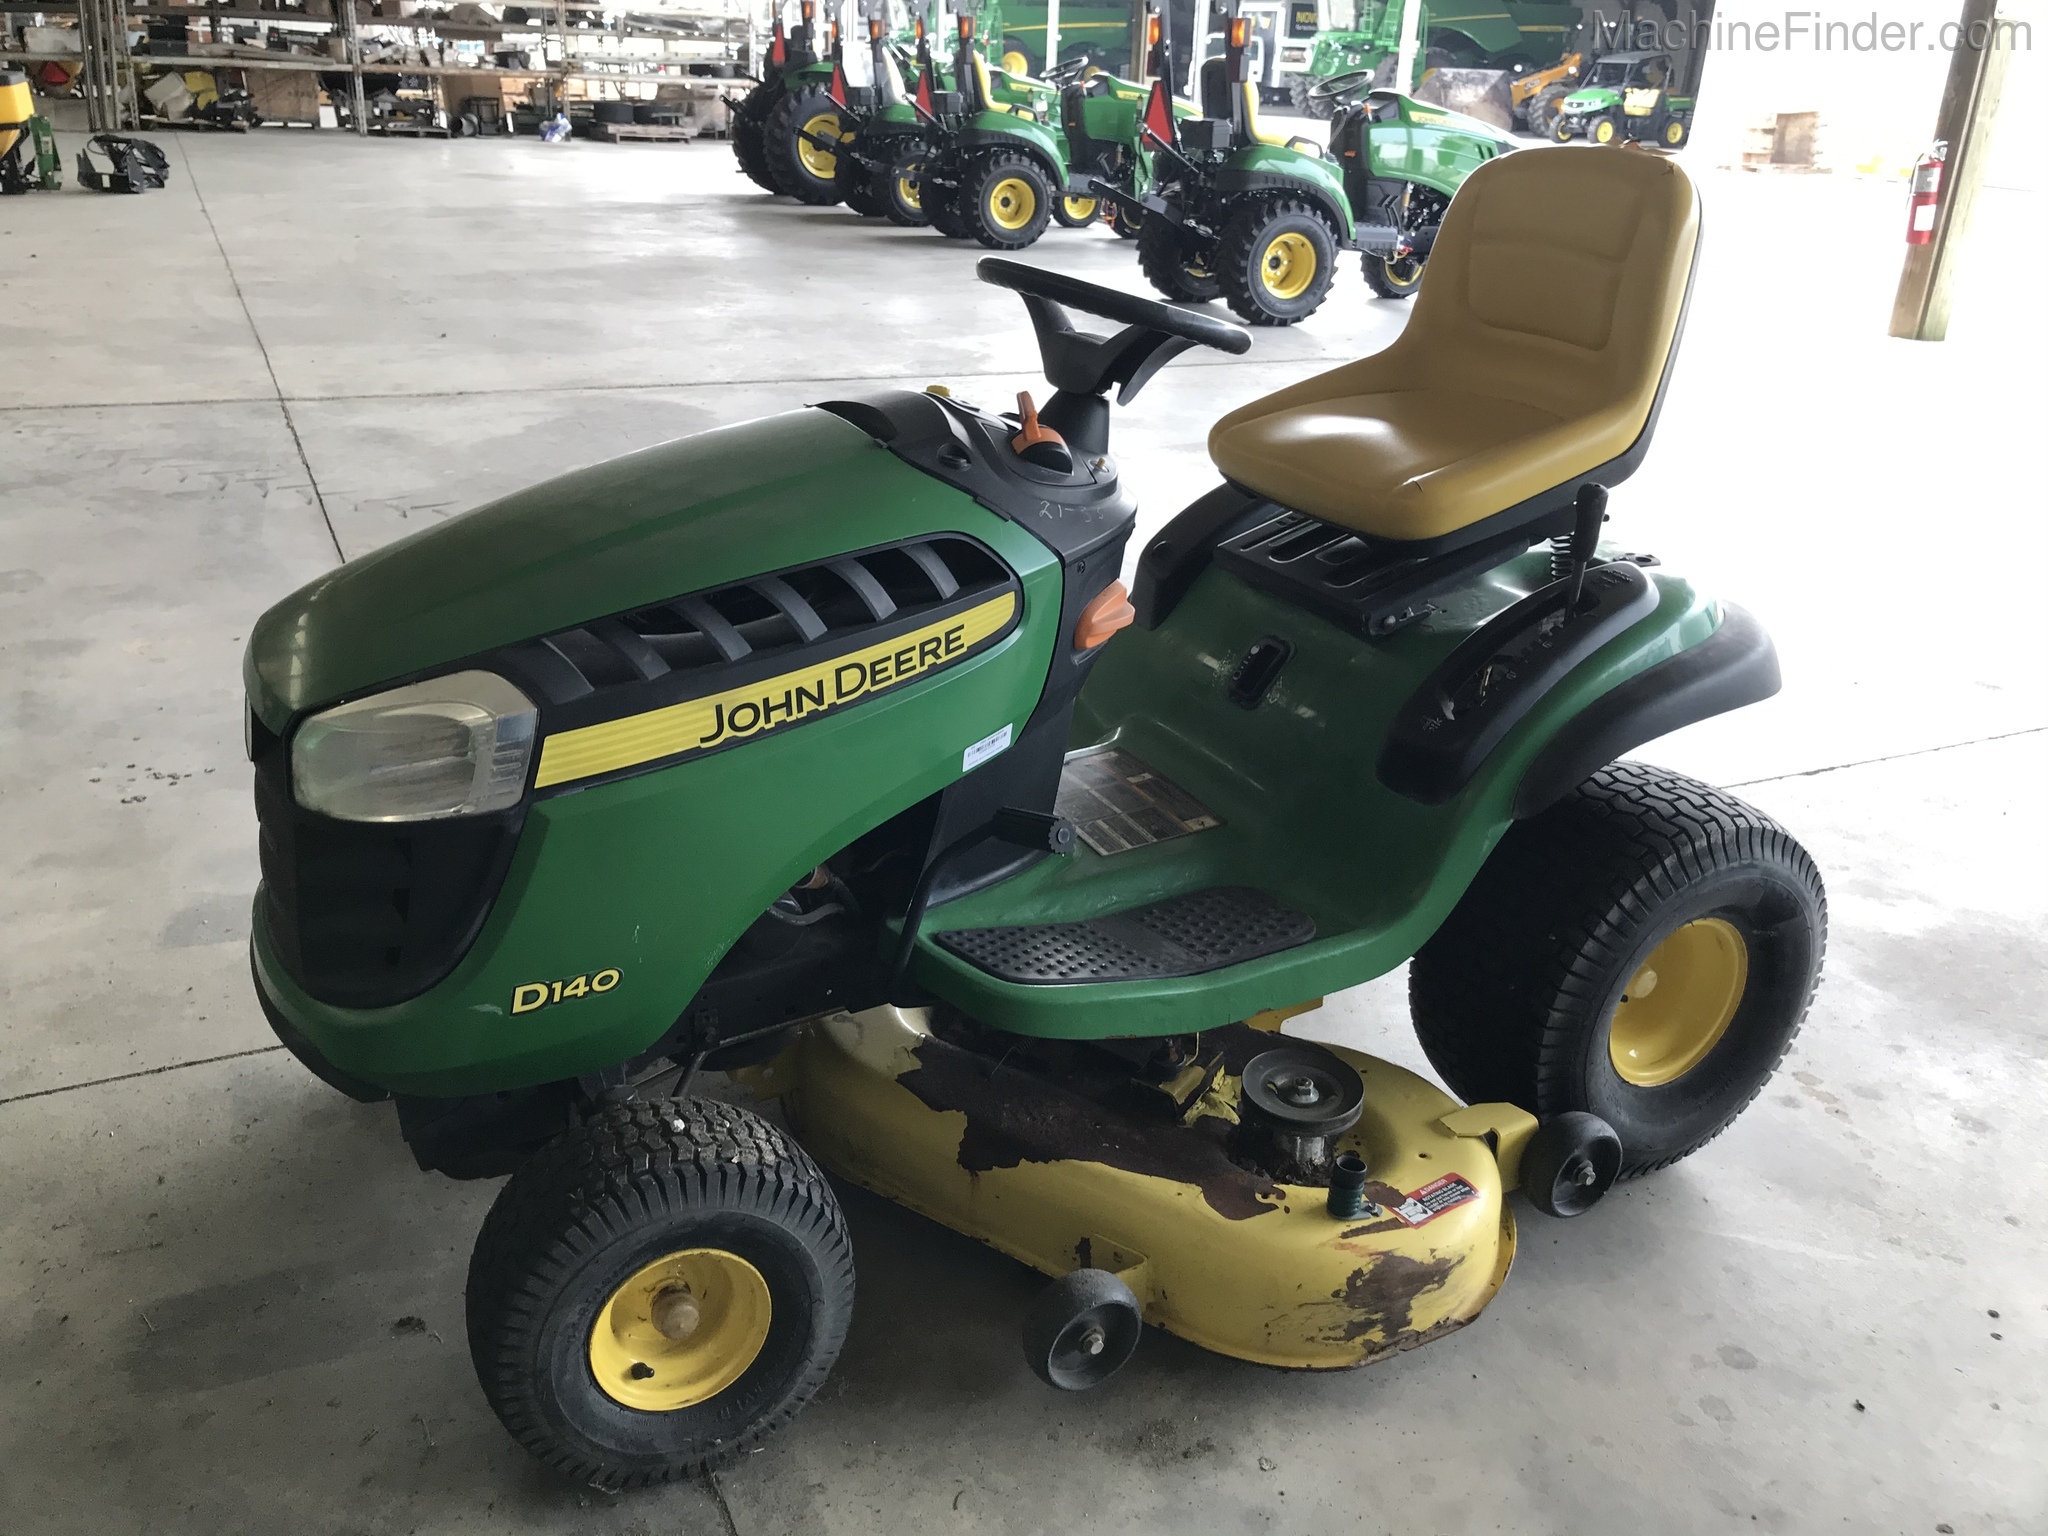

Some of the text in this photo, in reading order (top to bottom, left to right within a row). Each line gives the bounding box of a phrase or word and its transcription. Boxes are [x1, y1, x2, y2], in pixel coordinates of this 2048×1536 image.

[700, 624, 965, 744] JOHN DEERE
[511, 968, 621, 1014] D140
[1422, 1189, 1444, 1202] ROTATING
[1442, 1182, 1457, 1192] BLADE
[1424, 1178, 1448, 1192] DANGER
